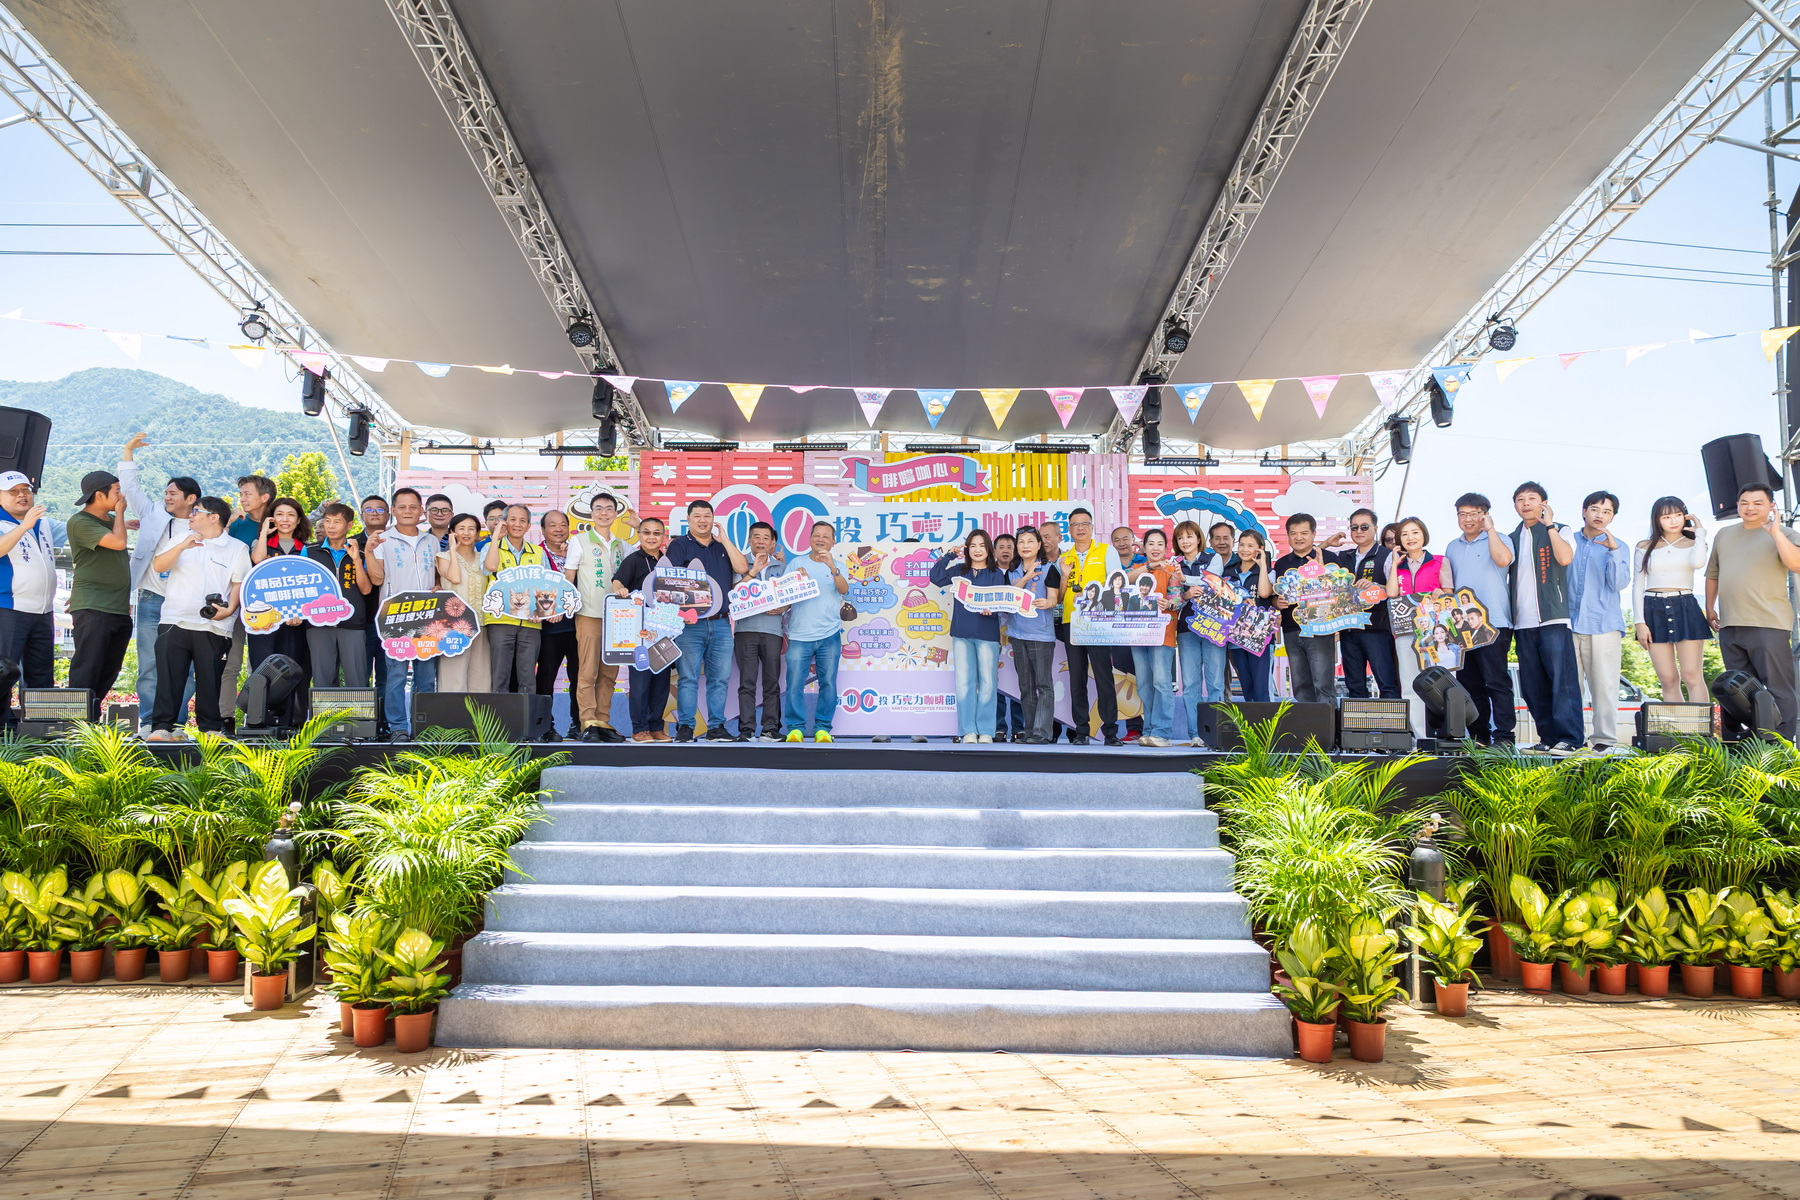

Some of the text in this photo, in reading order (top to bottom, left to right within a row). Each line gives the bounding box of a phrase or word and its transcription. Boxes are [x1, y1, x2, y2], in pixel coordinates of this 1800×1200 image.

[882, 463, 948, 488] 啡嚐咖心
[833, 516, 862, 542] 投
[254, 573, 323, 590] 精品巧克力
[500, 567, 541, 583] 毛小孩
[263, 587, 319, 602] 咖啡展售
[387, 598, 438, 615] 夏日夢幻
[385, 609, 436, 625] 璀璨煙火秀
[878, 696, 888, 705] 投
[892, 695, 956, 706] 巧克力咖啡節
